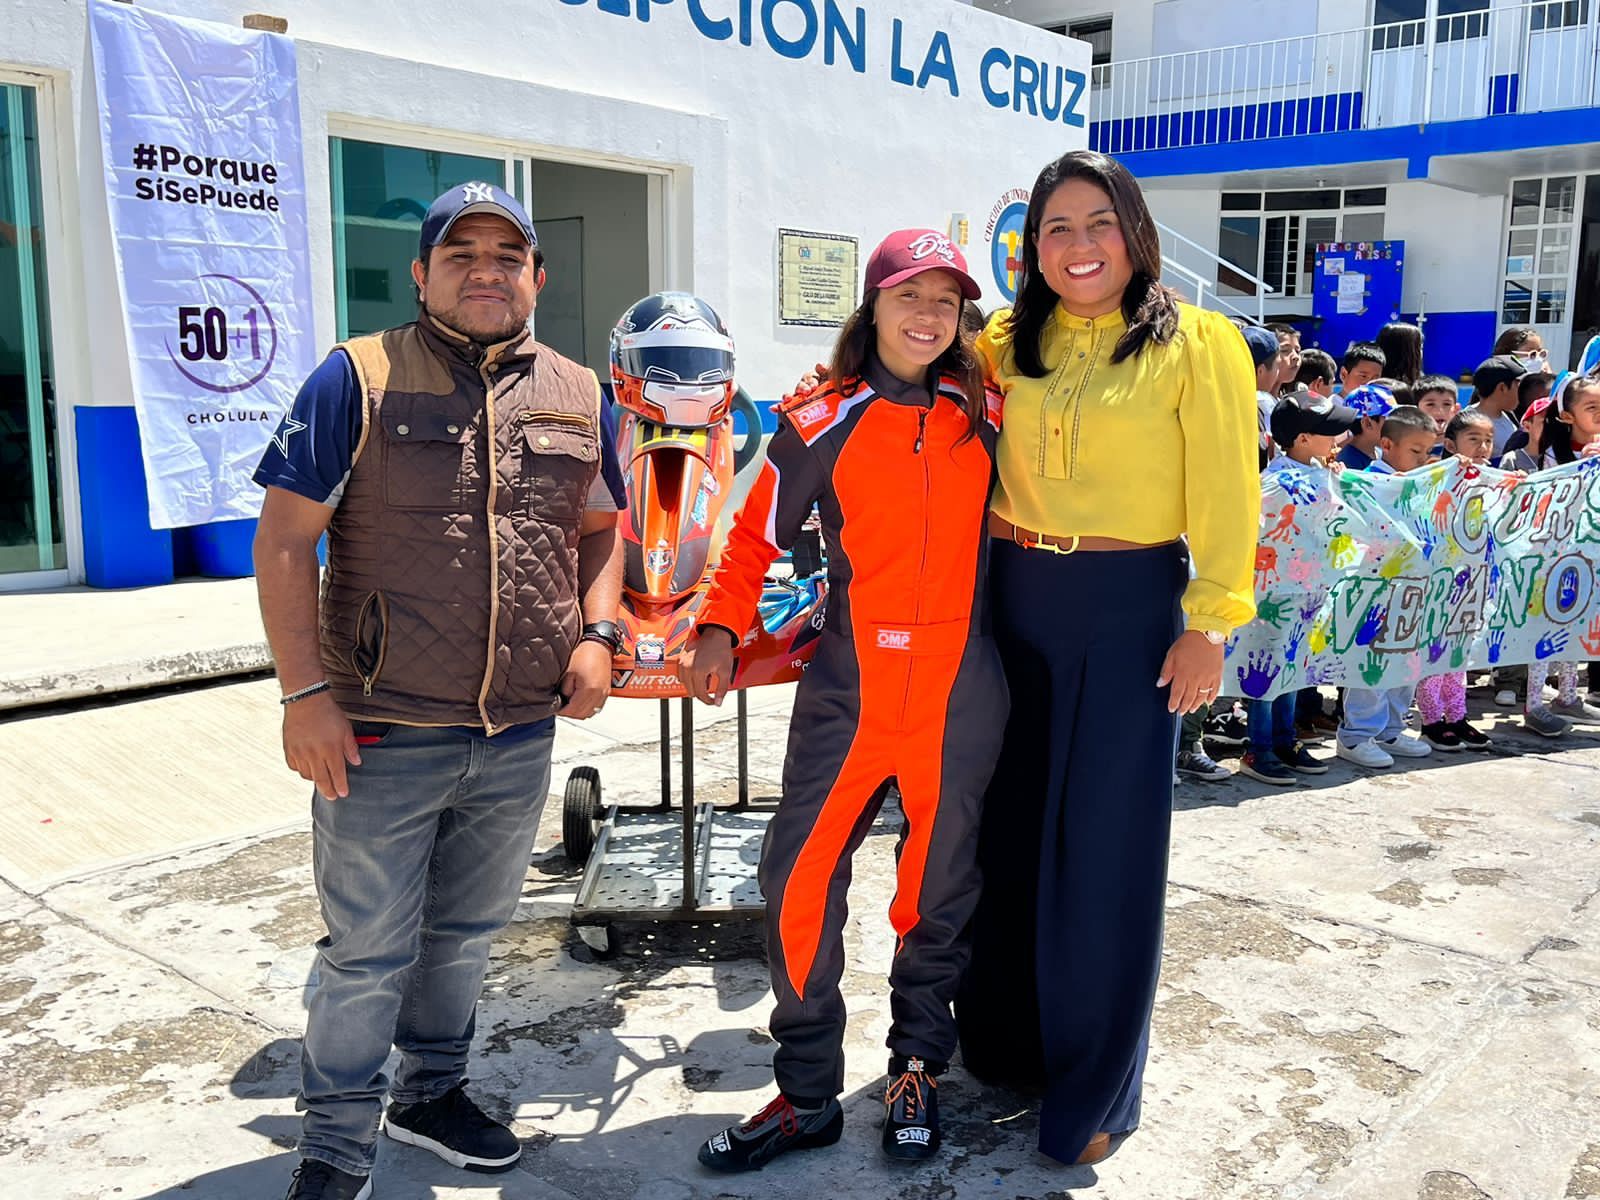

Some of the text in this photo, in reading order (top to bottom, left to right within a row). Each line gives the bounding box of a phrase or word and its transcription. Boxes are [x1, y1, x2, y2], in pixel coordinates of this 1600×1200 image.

[891, 18, 959, 97] LA
[980, 47, 1086, 128] CRUZ
[133, 143, 277, 185] #Porque
[135, 177, 279, 212] SíSePuede
[179, 307, 261, 361] 50+1
[187, 411, 269, 424] CHOLULA
[799, 402, 829, 423] OMP
[1330, 552, 1594, 654] VERANO
[877, 632, 911, 648] OMP
[896, 1129, 930, 1143] OMP
